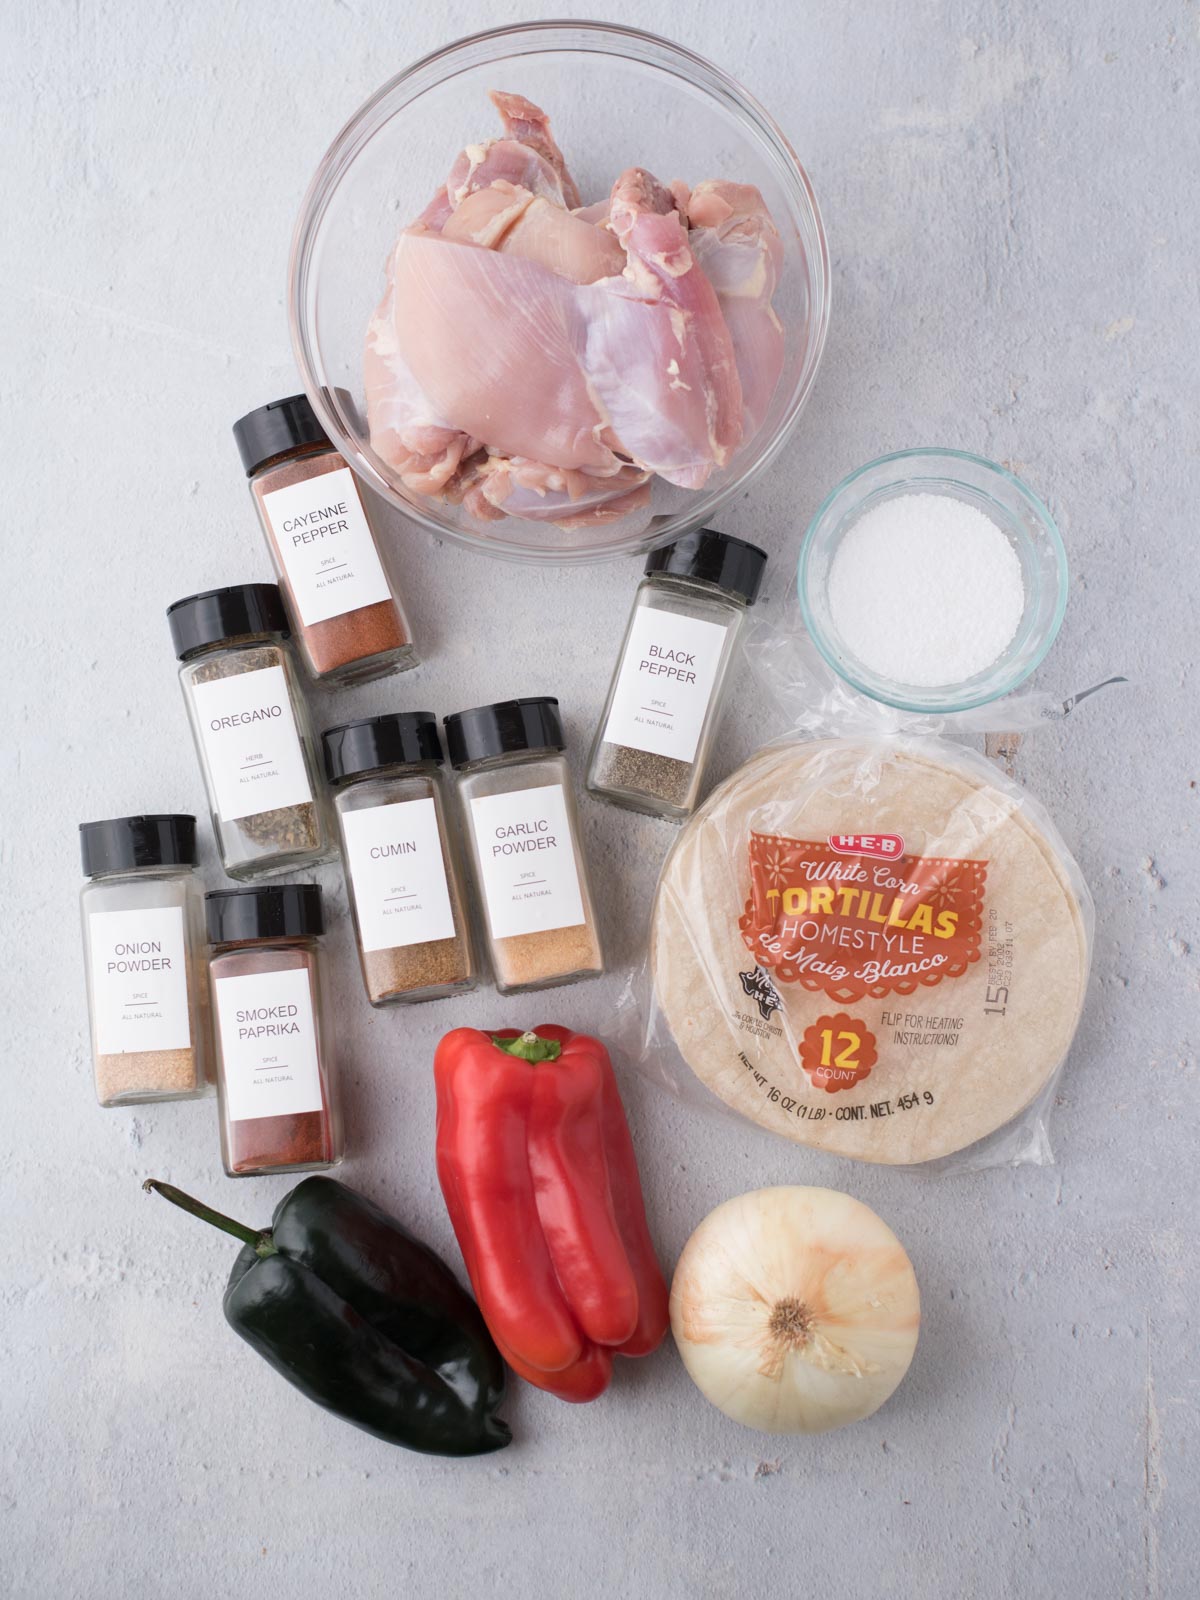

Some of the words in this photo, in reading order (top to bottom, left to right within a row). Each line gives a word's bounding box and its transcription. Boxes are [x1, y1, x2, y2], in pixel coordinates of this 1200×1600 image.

[283, 502, 349, 532] CAYENNE
[292, 519, 349, 547] PEPPER
[320, 557, 336, 567] SPICE
[316, 581, 327, 589] ALL
[327, 572, 355, 585] NATURAL
[648, 645, 696, 666] BLACK
[639, 660, 697, 684] PEPPER
[651, 699, 667, 708] SPICE
[210, 705, 282, 731] OREGANO
[646, 719, 674, 731] NATURAL
[245, 753, 263, 762] HERB
[239, 776, 250, 784] ALL
[251, 770, 279, 781] NATURAL
[495, 820, 549, 839] GARLIC
[370, 840, 417, 859] CUMIN
[492, 836, 557, 857] POWDER
[519, 871, 536, 880] SPICE
[800, 860, 869, 882] White
[873, 865, 921, 895] Corn
[390, 886, 406, 894] SPICE
[511, 893, 523, 901] ALL
[524, 889, 552, 899] NATURAL
[382, 908, 393, 916] ALL
[394, 903, 423, 914] NATURAL
[766, 886, 959, 940] TORTILLAS
[781, 919, 925, 955] HOMESTYLE
[114, 941, 162, 956] ONION
[107, 957, 172, 974] POWDER
[758, 932, 782, 954] de
[854, 953, 948, 984] Blanco
[988, 961, 996, 985] BEST
[132, 992, 148, 1000] SPICE
[983, 985, 1009, 1016] 15
[133, 1011, 163, 1020] NATURAL
[236, 1004, 298, 1023] SMOKED
[881, 1011, 903, 1026] FLIP
[904, 1014, 924, 1029] FOR
[925, 1016, 964, 1030] HEATING
[239, 1022, 300, 1040] PAPRIKA
[820, 1029, 861, 1069] 12
[262, 1056, 278, 1064] SPICE
[253, 1077, 264, 1085] ALL
[264, 1075, 294, 1084] NATURAL
[816, 1066, 857, 1081] COUNT
[766, 1086, 782, 1102] 16
[780, 1096, 797, 1113] OZ
[807, 1106, 826, 1121] LB)
[835, 1105, 868, 1121] CONT.
[869, 1100, 895, 1119] NET.
[897, 1091, 920, 1111] 454
